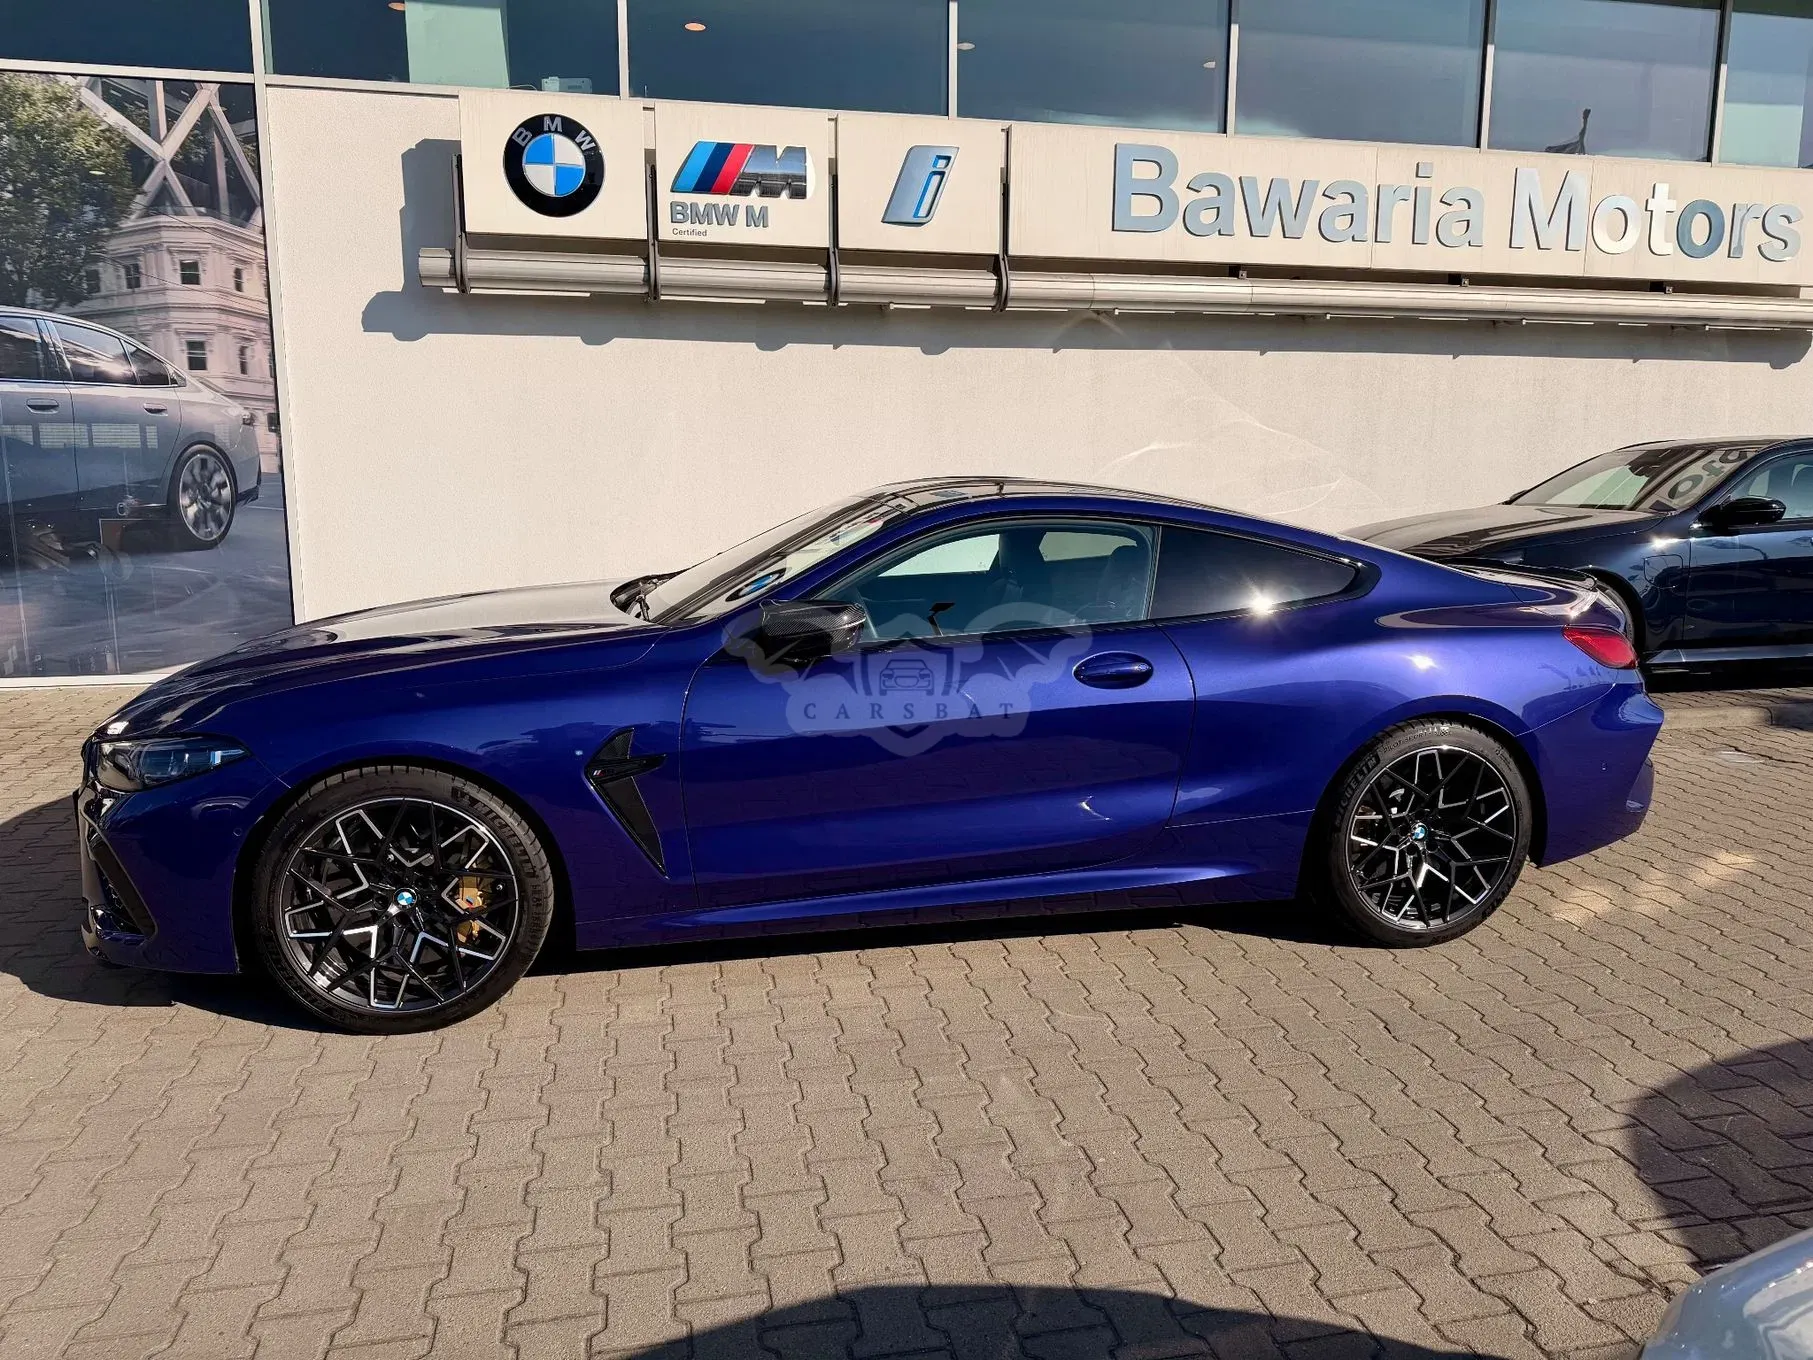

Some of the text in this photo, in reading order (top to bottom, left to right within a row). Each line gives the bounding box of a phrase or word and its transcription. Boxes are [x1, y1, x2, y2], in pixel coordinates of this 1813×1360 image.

[512, 116, 596, 151] BMW
[670, 200, 769, 228] BMW M
[1112, 143, 1803, 262] Bawaria Motors
[672, 227, 708, 237] Certified
[1336, 755, 1379, 826] MICHELIN
[473, 801, 537, 878] MICHELIN
